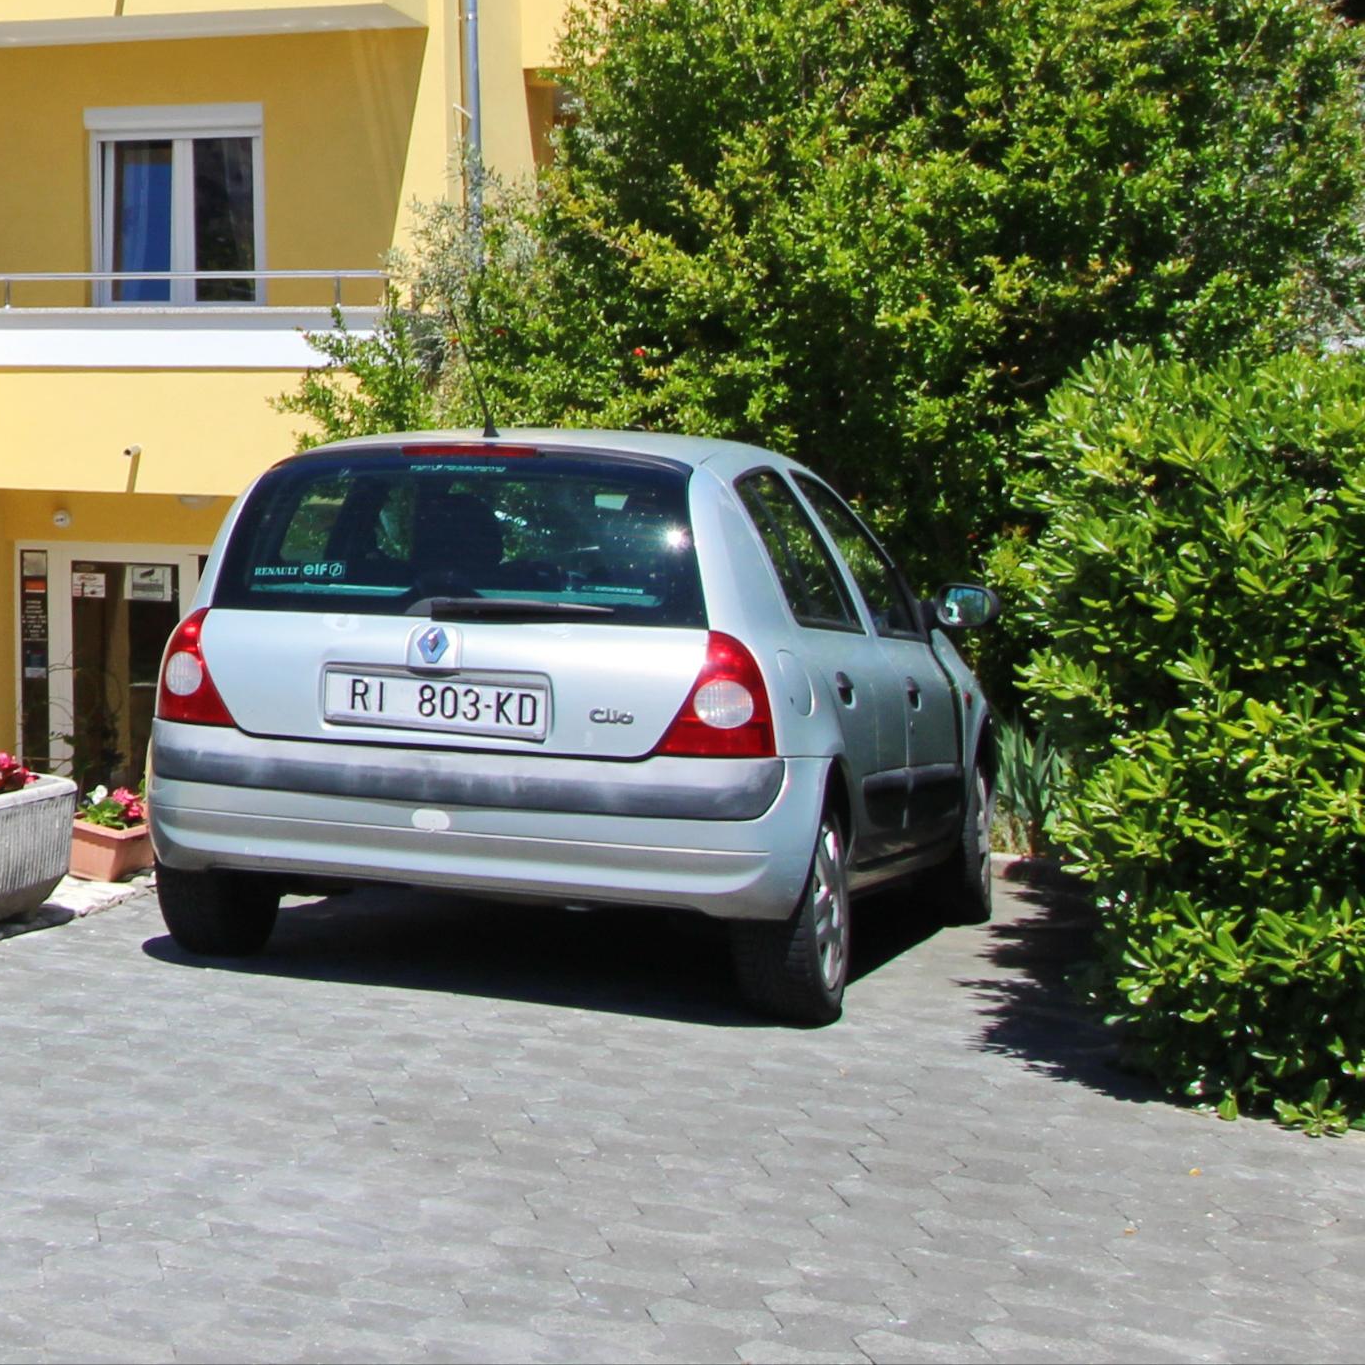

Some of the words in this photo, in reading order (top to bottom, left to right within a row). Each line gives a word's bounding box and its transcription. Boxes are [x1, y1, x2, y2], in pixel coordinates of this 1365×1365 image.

[254, 566, 299, 576] RENAULT
[303, 563, 328, 576] elf
[350, 678, 384, 712] RI
[417, 684, 537, 727] 803-KD
[589, 707, 635, 725] Clio
